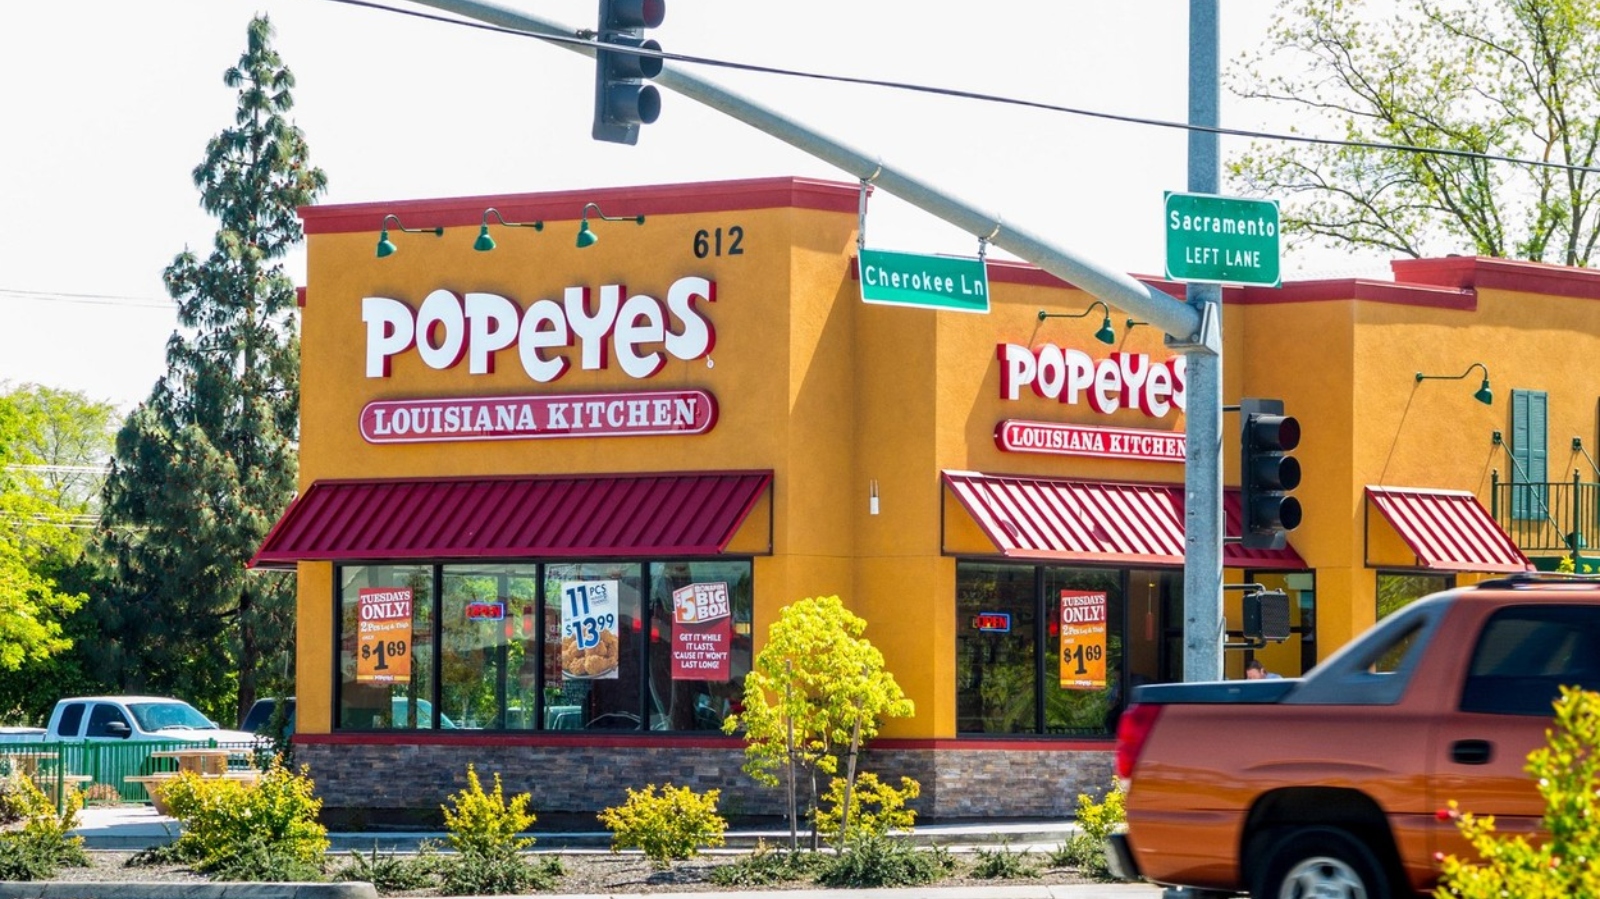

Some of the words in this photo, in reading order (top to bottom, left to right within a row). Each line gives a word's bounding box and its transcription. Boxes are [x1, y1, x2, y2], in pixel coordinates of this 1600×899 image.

[1170, 210, 1275, 238] Sacramento
[693, 226, 744, 258] 612
[1185, 246, 1220, 265] LEFT
[1225, 249, 1261, 268] LANE
[865, 265, 954, 293] Cherokee
[961, 274, 984, 296] Ln
[373, 404, 536, 435] LOUISIANA
[547, 398, 697, 429] KITCHEN
[1011, 425, 1104, 451] LOUISIANA
[361, 591, 411, 604] TUESDAYS
[566, 585, 590, 617] 11
[675, 589, 696, 621] $5
[696, 590, 725, 606] BIG
[1062, 595, 1105, 607] TUESDAYS
[361, 602, 411, 620] ONLY!
[698, 603, 727, 619] BOX
[1063, 605, 1105, 623] ONLY!
[361, 622, 367, 632] 2
[977, 616, 1007, 629] OPEN
[1062, 625, 1069, 635] 2
[679, 633, 692, 641] GET
[694, 633, 700, 641] IT
[701, 633, 722, 641] WHILE
[673, 651, 695, 659] 'CAUSE
[697, 651, 704, 659] IT
[693, 643, 715, 651] LASTS,
[681, 660, 697, 668] LAST
[699, 660, 720, 669] LONG!
